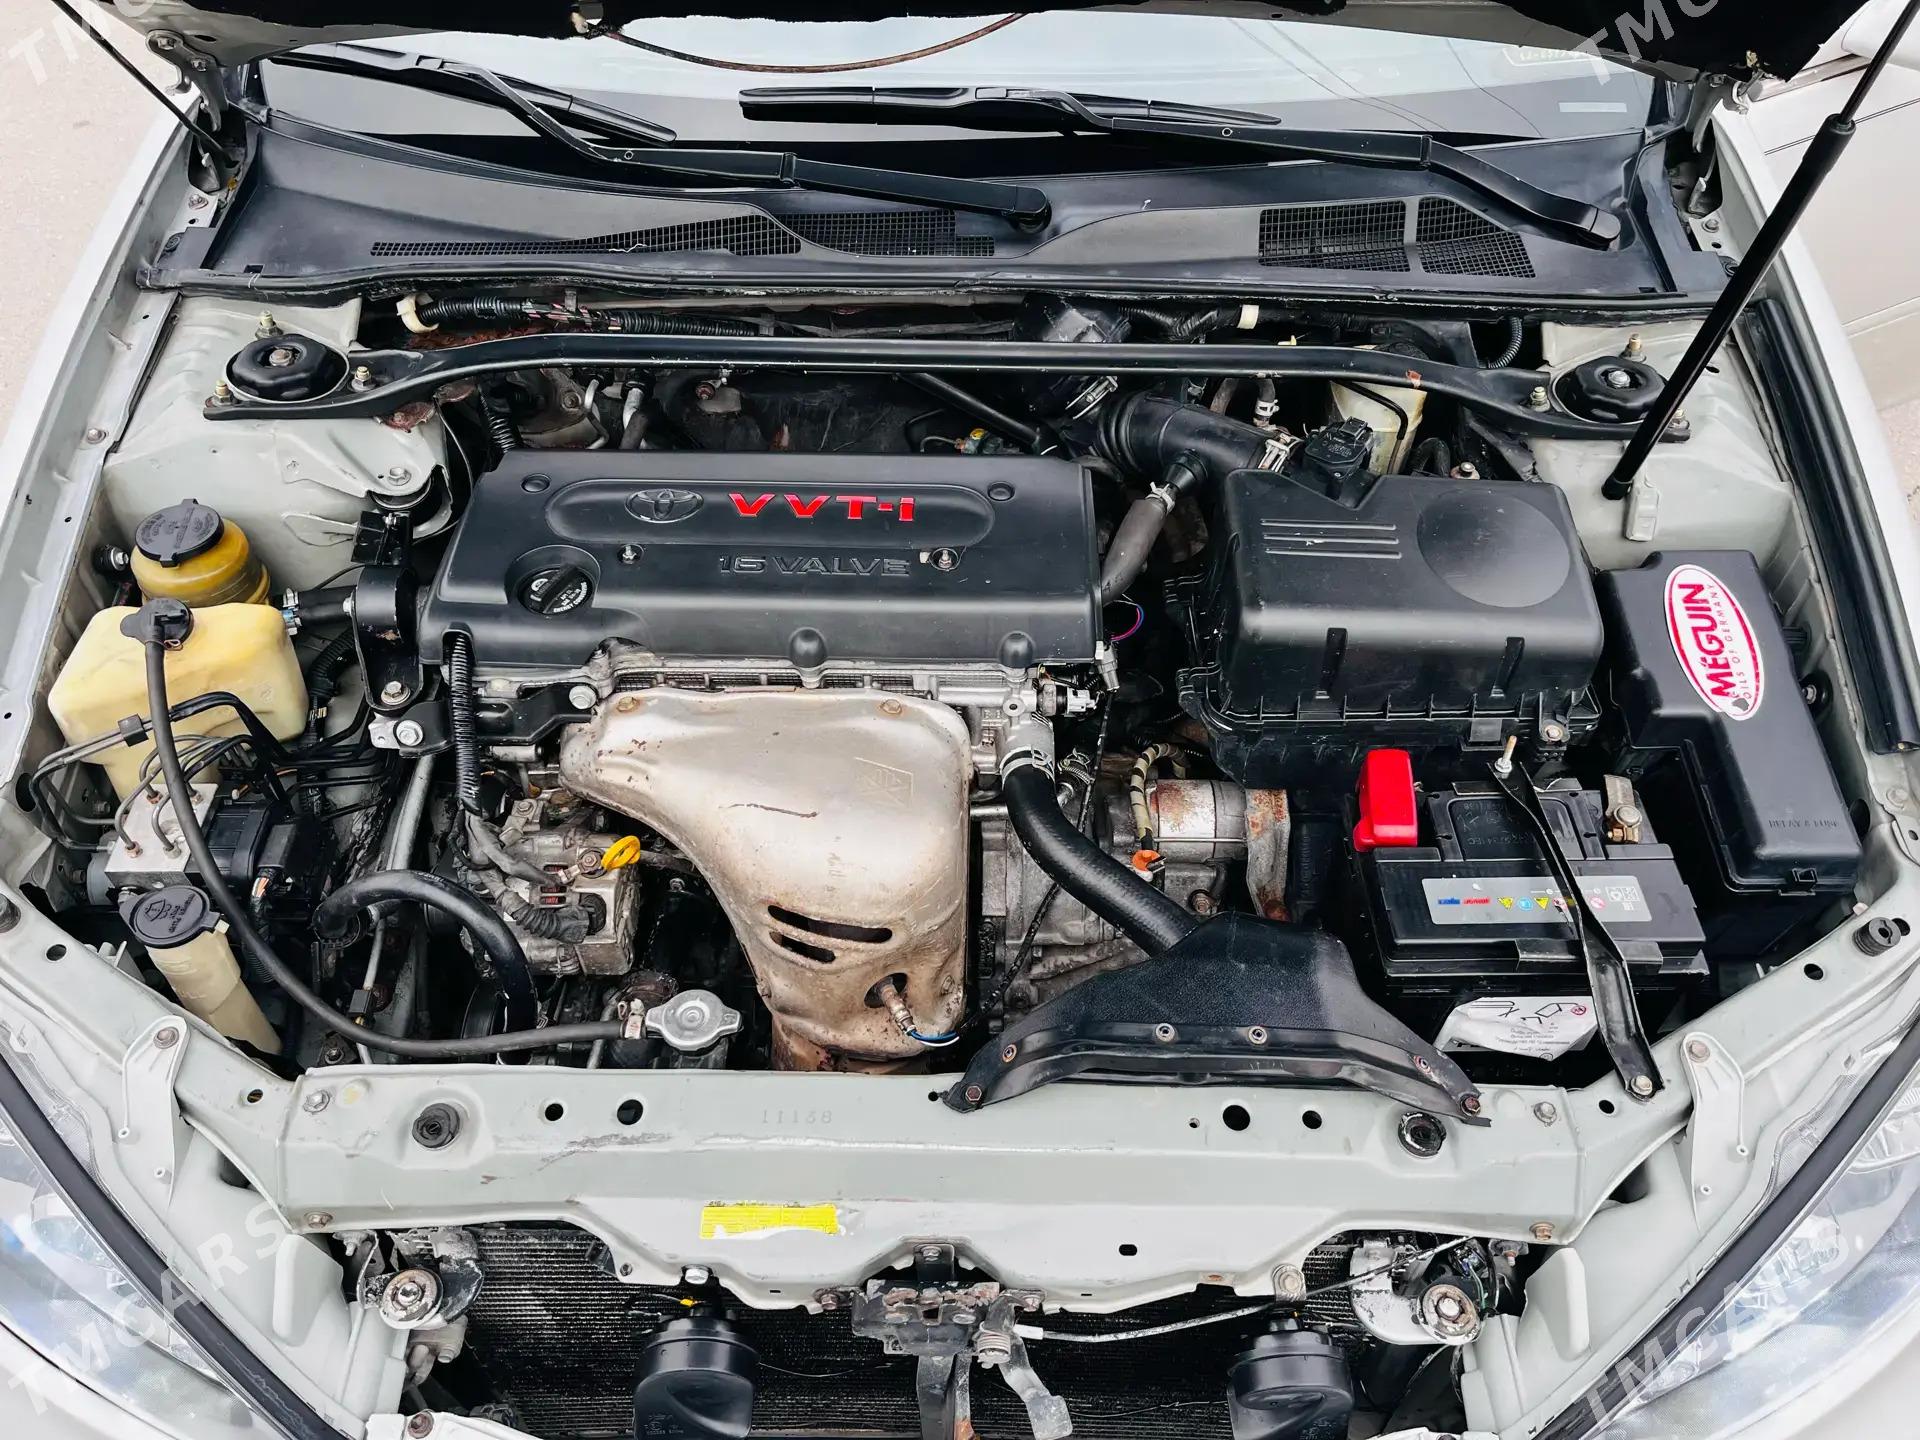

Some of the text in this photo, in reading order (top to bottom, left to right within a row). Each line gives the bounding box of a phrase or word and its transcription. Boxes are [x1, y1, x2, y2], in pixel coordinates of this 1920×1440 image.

[719, 555, 910, 577] 16 VALVE
[1707, 584, 1753, 700] OILS OF GERMANY
